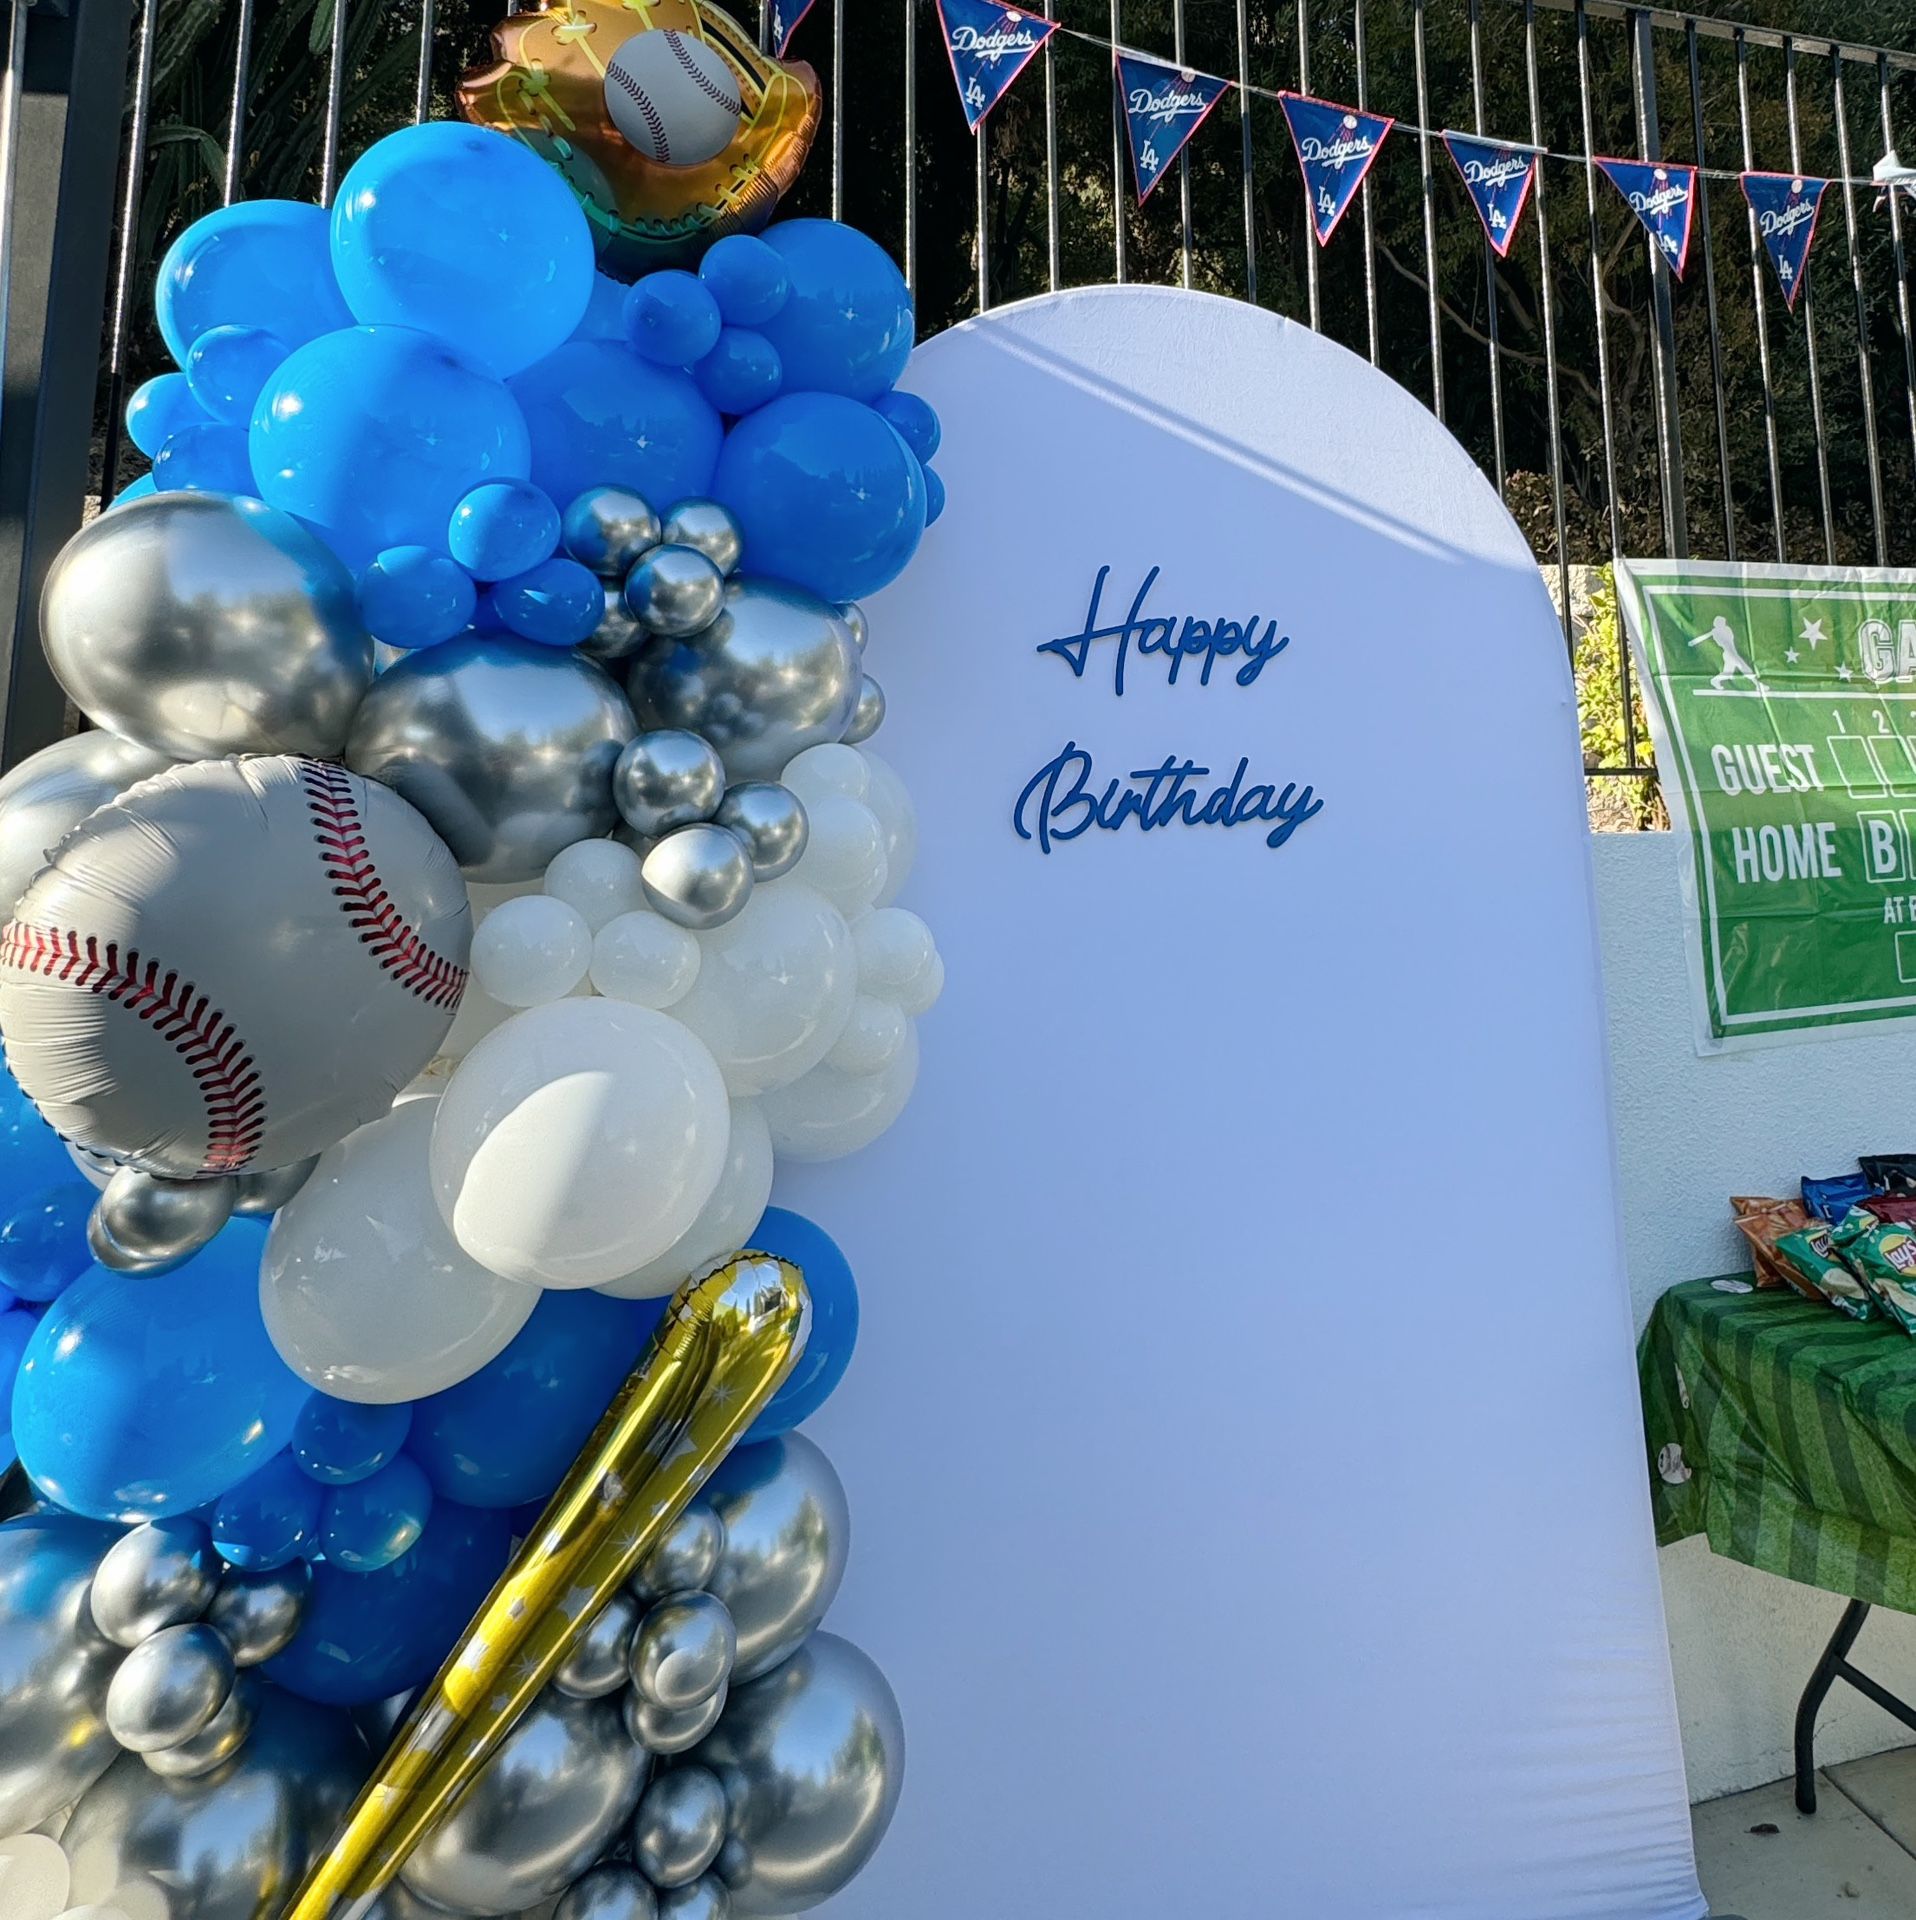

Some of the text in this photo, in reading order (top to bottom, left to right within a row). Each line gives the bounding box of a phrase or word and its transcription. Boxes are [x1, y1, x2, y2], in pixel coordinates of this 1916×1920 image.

[950, 26, 1036, 62] Dodgers
[965, 76, 986, 110] LA
[1128, 88, 1208, 123] Dodgers
[1140, 140, 1160, 173] LA
[1301, 136, 1374, 170] Dodgers
[1463, 155, 1530, 187] Dodgers
[1317, 186, 1336, 217] LA
[1487, 203, 1507, 229] LA
[1628, 183, 1689, 215] Dodgers
[1760, 198, 1815, 237] Dodgers
[1778, 255, 1793, 281] LA
[1036, 565, 1290, 696] Happy
[1832, 709, 1846, 734] 1
[1872, 709, 1890, 734] 2
[1711, 743, 1825, 796] GUEST
[1013, 741, 1325, 855] Birthday
[1731, 819, 1897, 884] HOME B
[1883, 895, 1904, 924] AT
